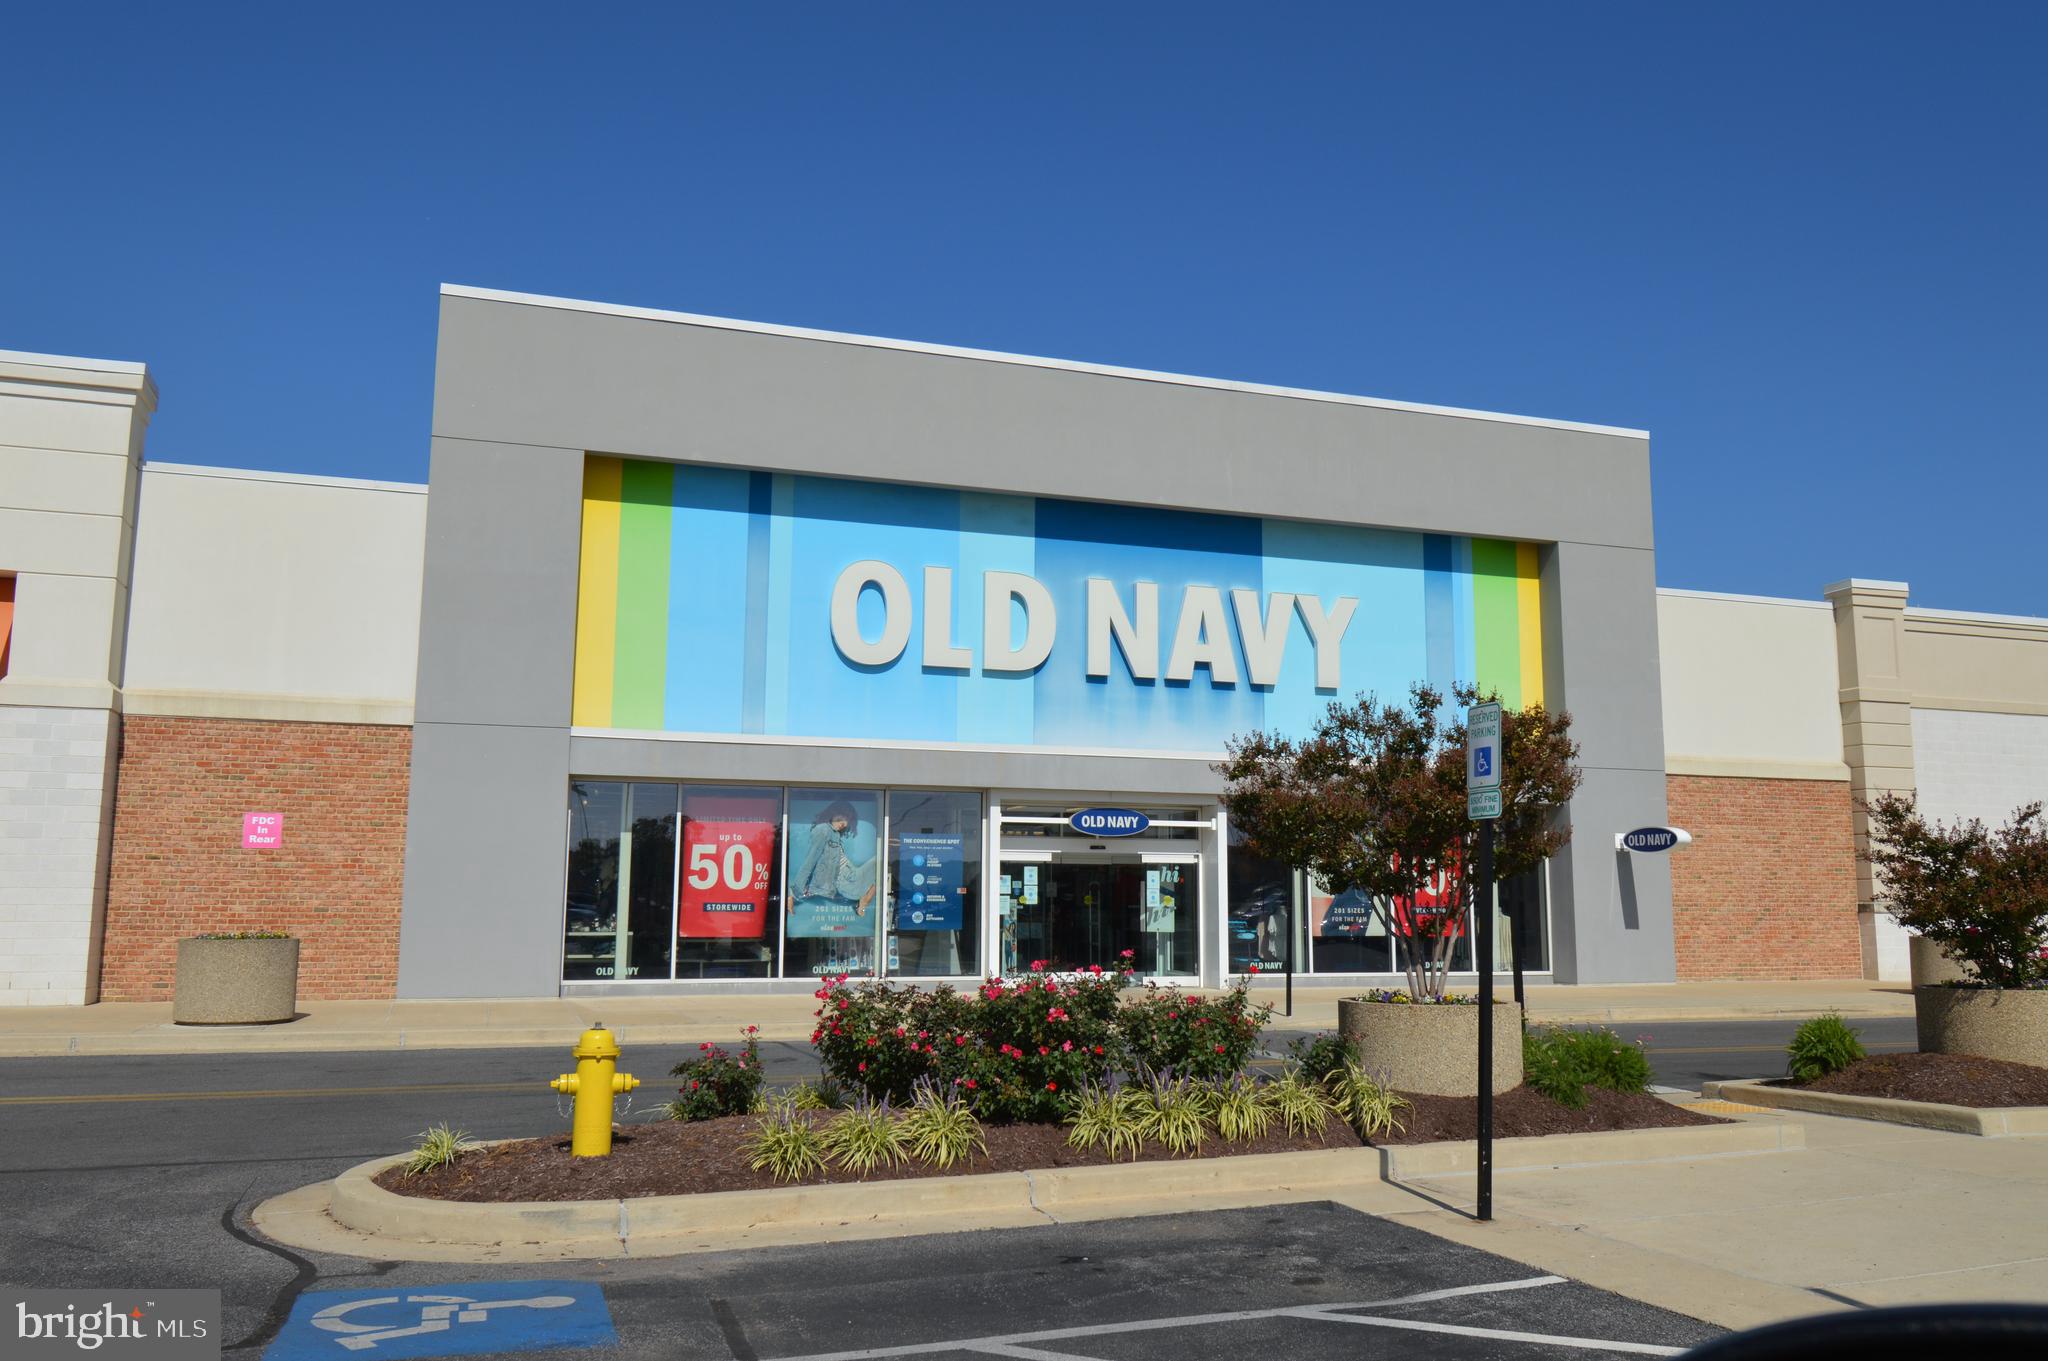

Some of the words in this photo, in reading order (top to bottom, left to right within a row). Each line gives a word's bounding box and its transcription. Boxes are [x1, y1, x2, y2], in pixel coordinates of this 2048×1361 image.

[830, 560, 1057, 672] OLD
[1085, 578, 1360, 689] NAVY
[1470, 710, 1498, 725] RESERVED
[1471, 725, 1496, 738] PARKING
[1484, 793, 1498, 804] FINE
[252, 816, 275, 825] FDC
[1081, 814, 1105, 828] OLD
[1107, 815, 1139, 829] NAVY
[257, 826, 268, 834] In
[249, 835, 276, 843] Rear
[1628, 834, 1646, 846] OLD
[1647, 833, 1672, 846] NAVY
[754, 882, 768, 890] OFF
[812, 966, 829, 974] OLD
[830, 966, 851, 974] NAVY
[1264, 961, 1283, 970] NAVY
[595, 966, 614, 976] OLD
